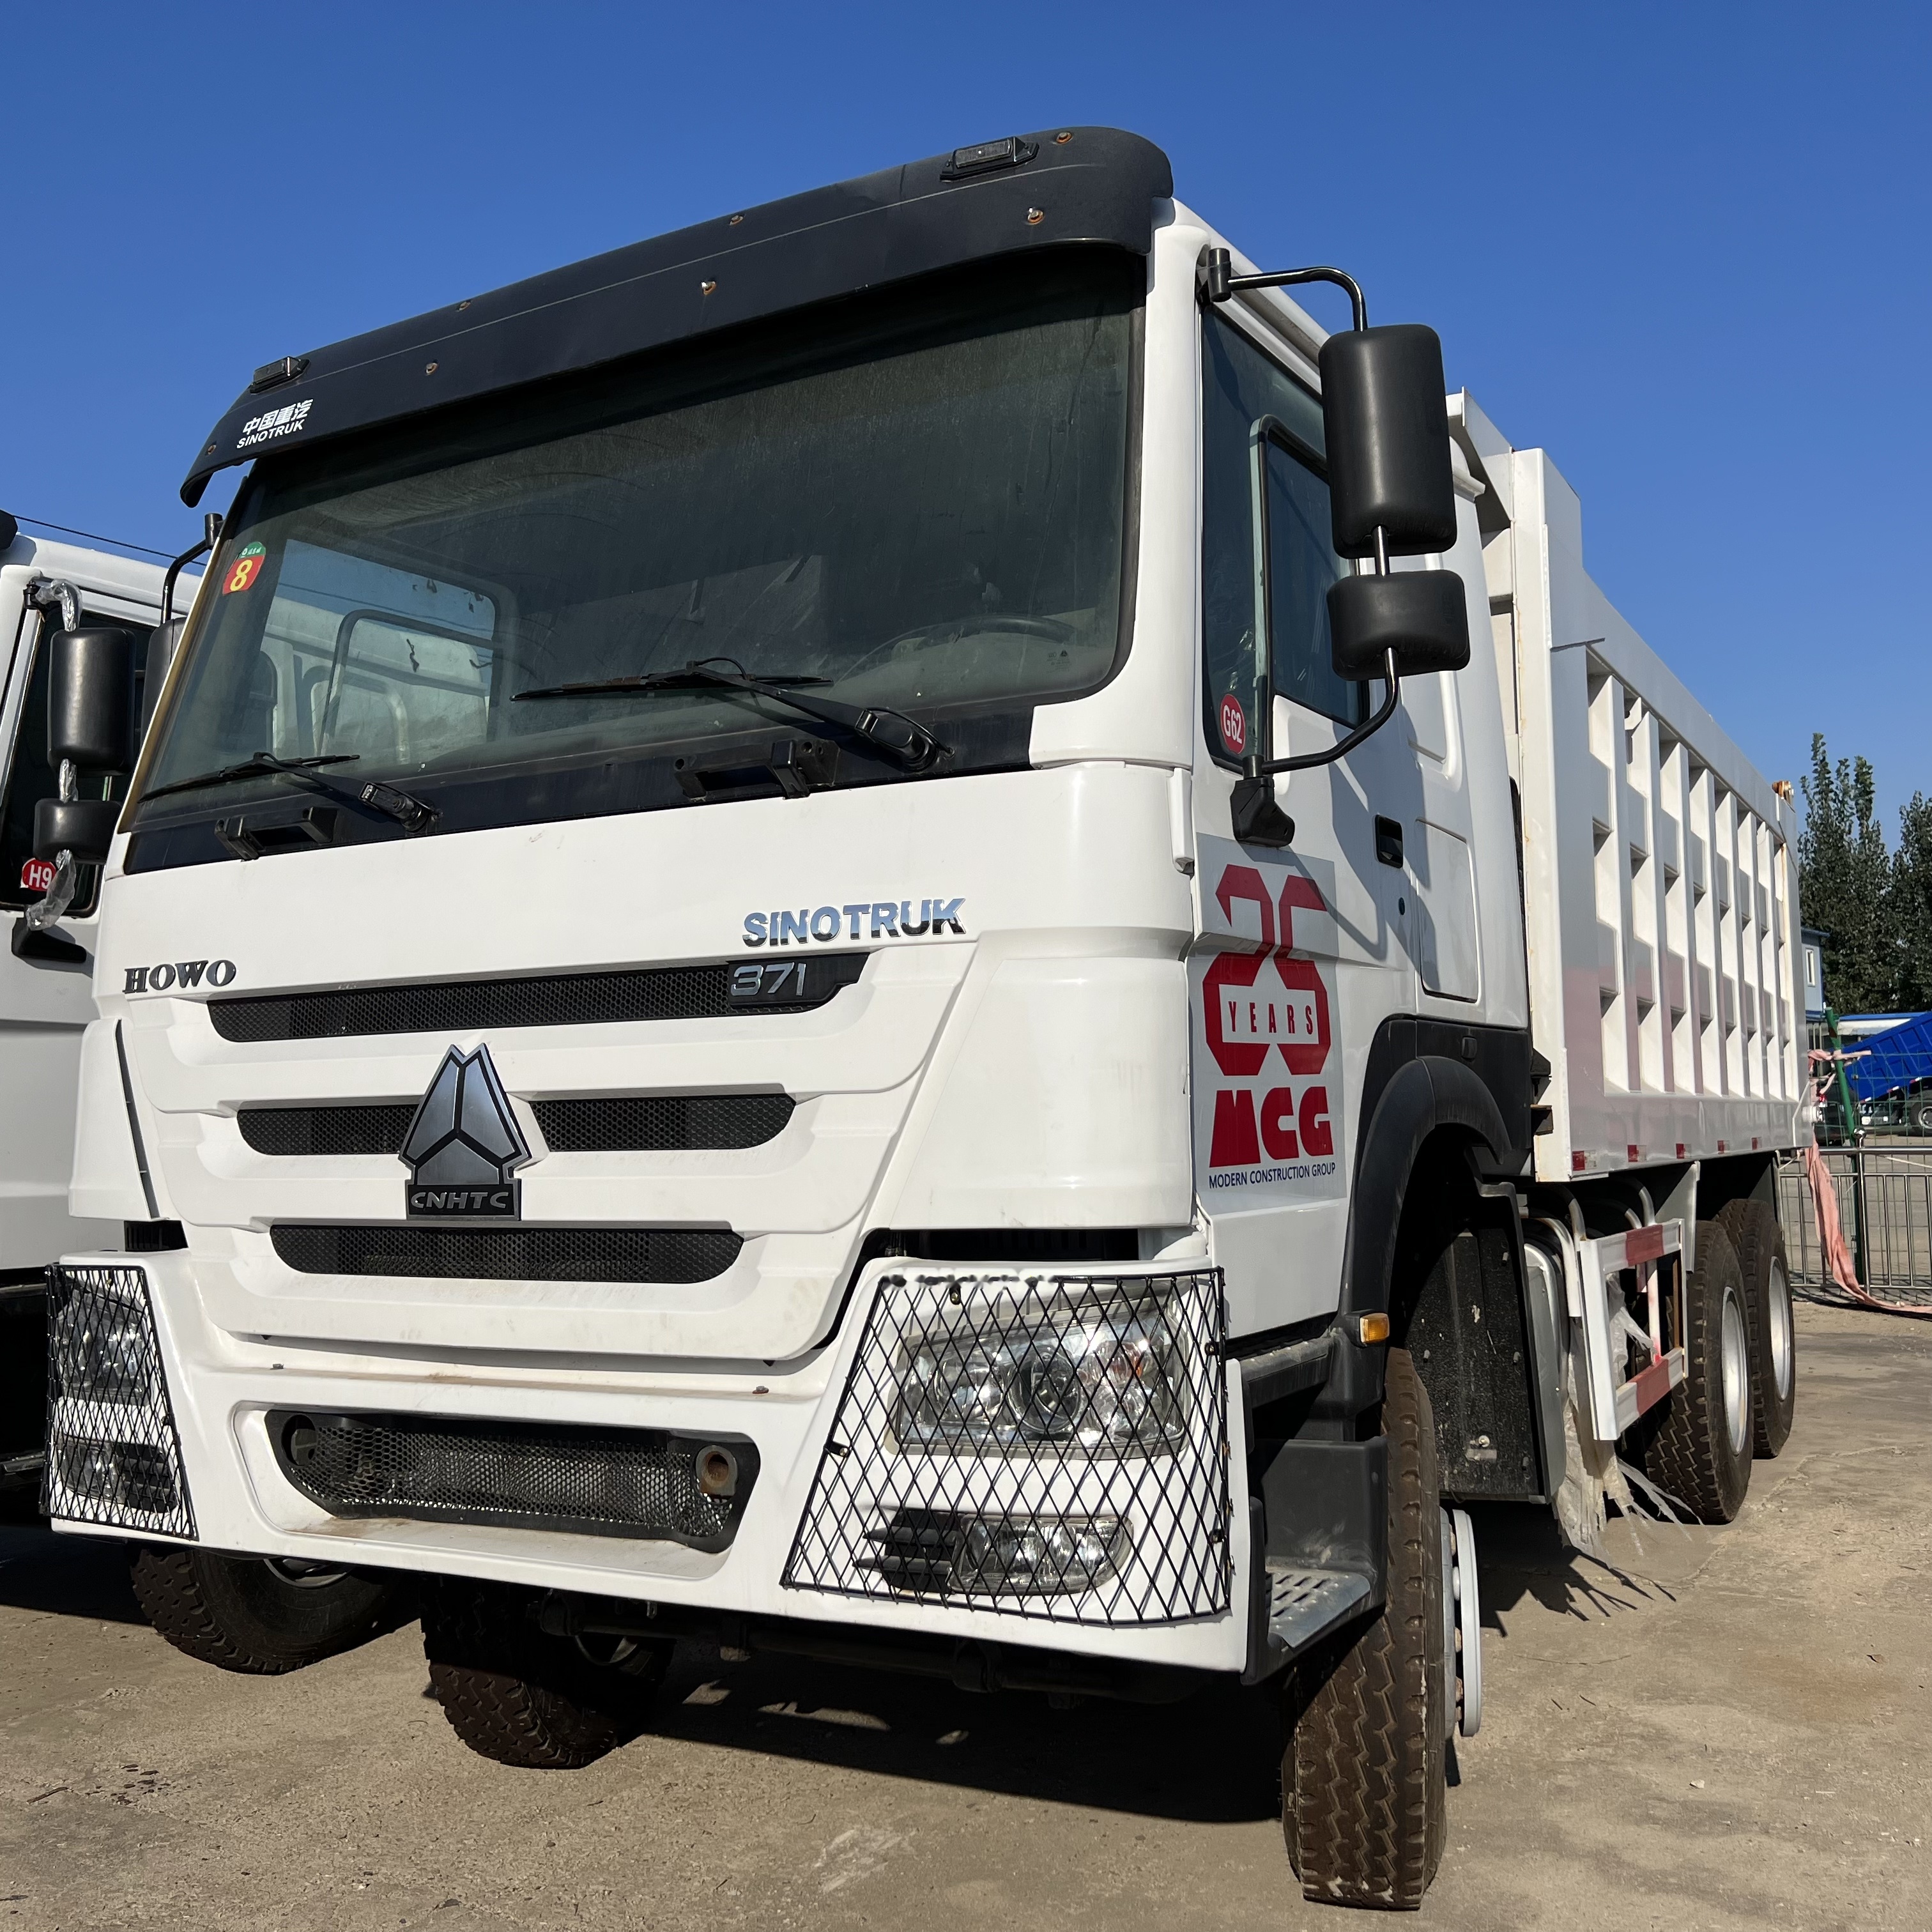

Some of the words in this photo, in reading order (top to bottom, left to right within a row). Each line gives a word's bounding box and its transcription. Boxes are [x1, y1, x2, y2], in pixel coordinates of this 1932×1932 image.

[236, 418, 305, 448] SINOTRUK
[243, 399, 314, 435] 中国重汽
[230, 560, 253, 592] 8
[1223, 705, 1243, 744] G62
[29, 864, 52, 889] H9
[742, 898, 966, 947] SINOTRUK
[122, 960, 236, 994] HOWO
[731, 962, 806, 996] 371
[1228, 1000, 1313, 1035] YEARS
[1209, 1086, 1334, 1168] MCG
[1209, 1172, 1247, 1189] MODERN
[1250, 1165, 1310, 1184] CONSTRUCTION
[1312, 1162, 1335, 1177] GROUP
[411, 1192, 509, 1210] CNHTC
